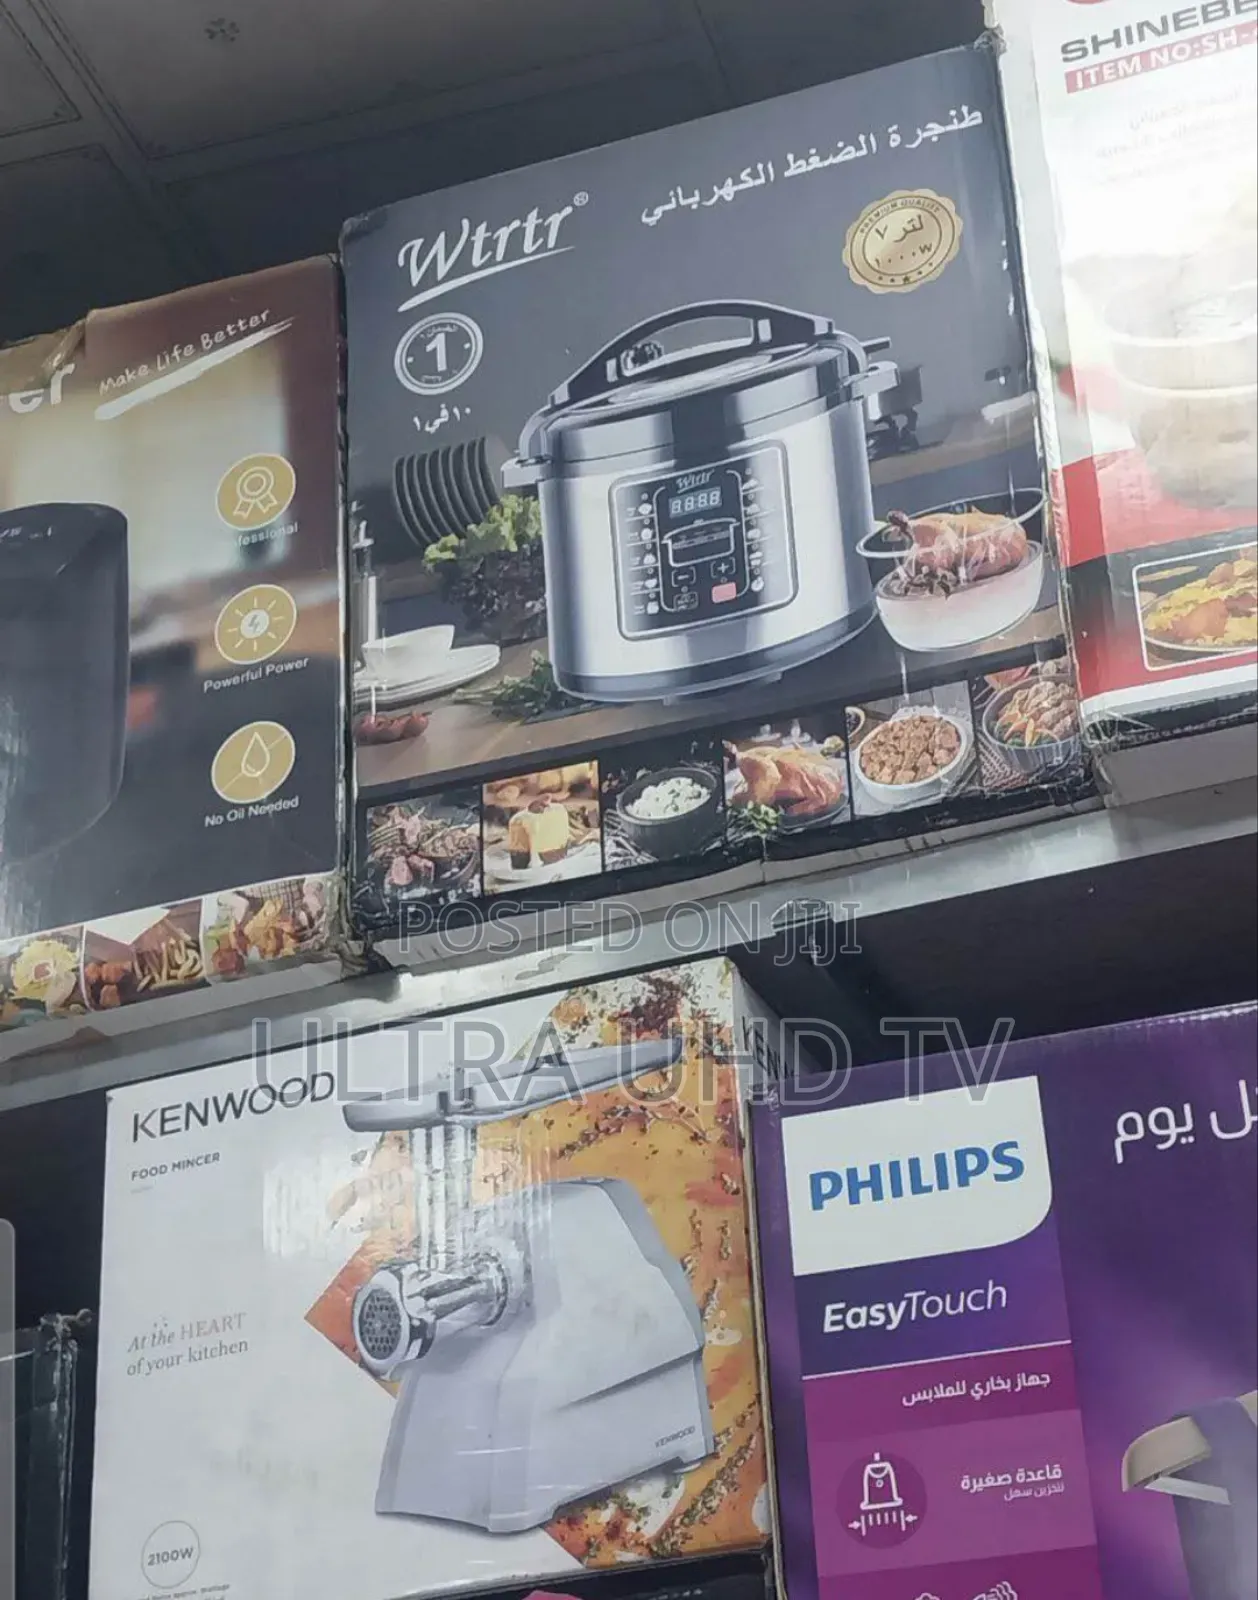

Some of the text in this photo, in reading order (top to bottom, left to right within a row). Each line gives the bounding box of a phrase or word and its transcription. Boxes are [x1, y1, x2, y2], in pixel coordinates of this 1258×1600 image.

[1075, 26, 1257, 89] ITEM NO:SH-
[889, 104, 984, 149] طنجرة
[784, 131, 878, 178] الضغط
[99, 308, 271, 396] Make Life Better
[425, 332, 448, 373] 1
[203, 657, 310, 693] Powerful Power
[204, 795, 300, 828] No Oil Needed
[132, 1071, 335, 1143] KENWOOD
[1114, 1102, 1195, 1164] يوم
[131, 1151, 220, 1182] FOOD MINCER
[809, 1140, 1025, 1212] PHILIPS
[822, 1279, 1008, 1334] EasyTouch
[127, 1312, 247, 1354] At the HEART
[126, 1339, 250, 1377] of your kitchen
[901, 1372, 1052, 1407] جهاز بخاري للملابس
[960, 1463, 1063, 1494] قاعدة صغيرة
[147, 1547, 194, 1567] 2100W
